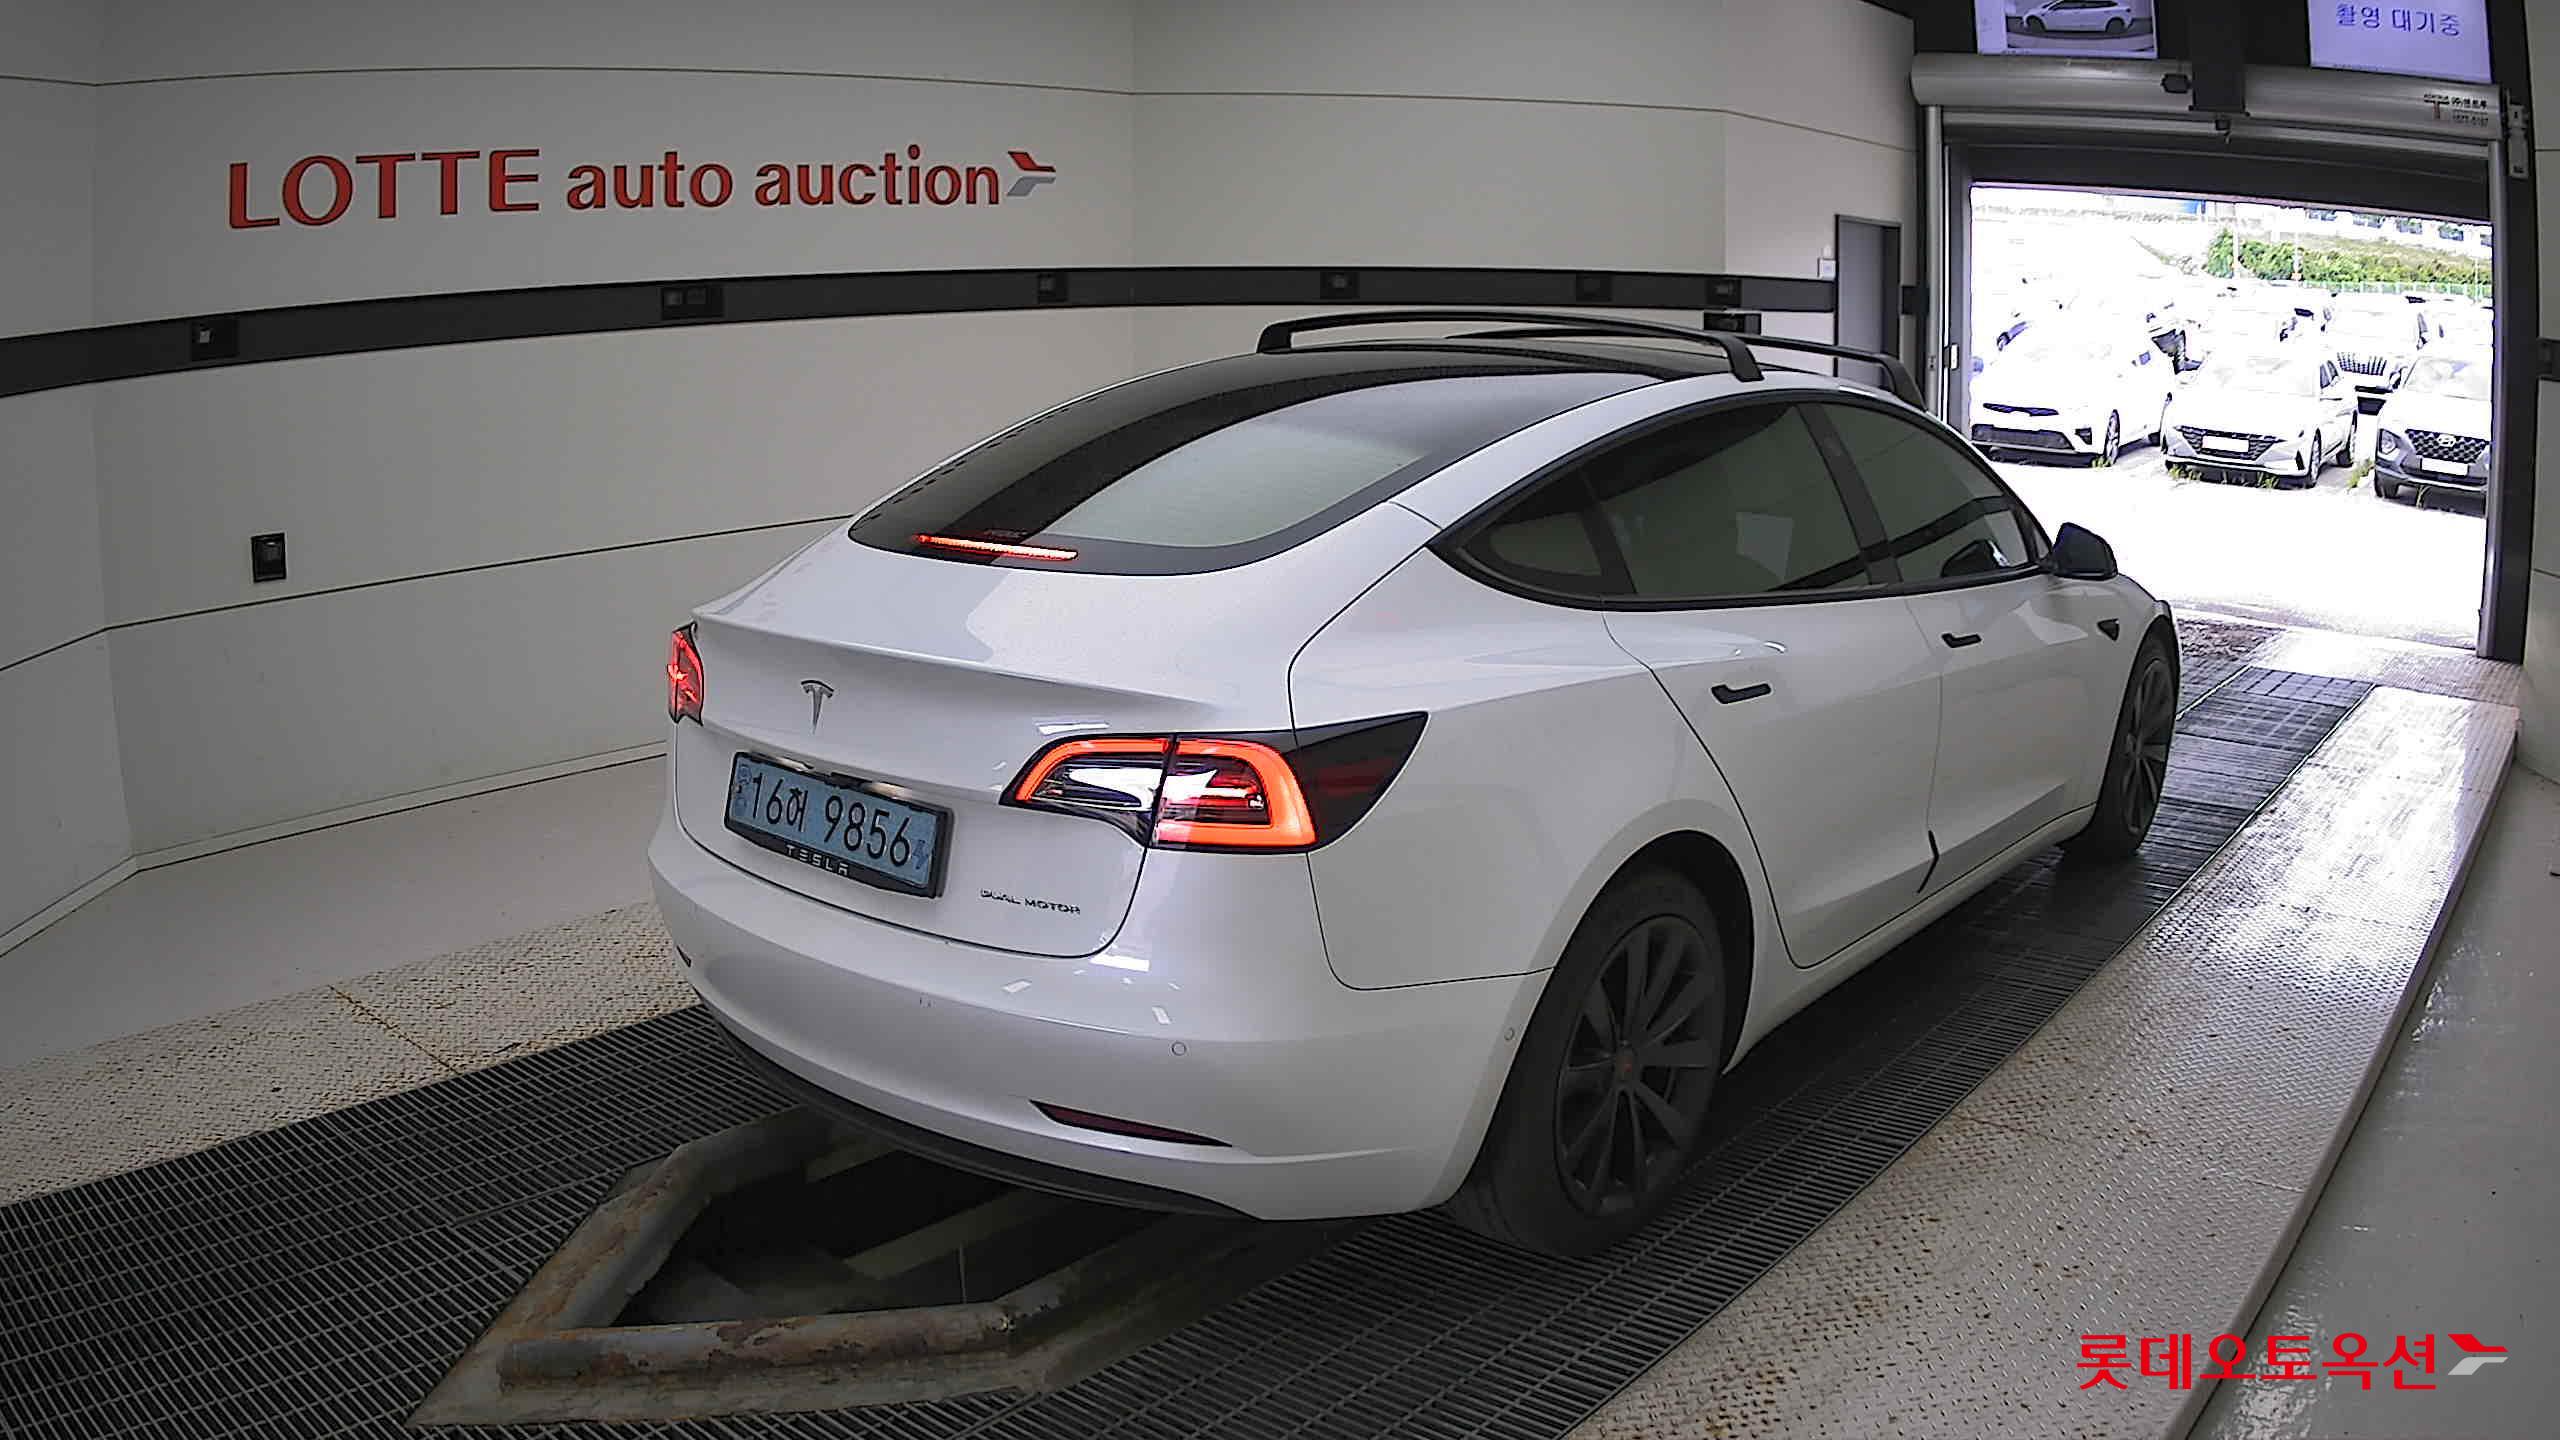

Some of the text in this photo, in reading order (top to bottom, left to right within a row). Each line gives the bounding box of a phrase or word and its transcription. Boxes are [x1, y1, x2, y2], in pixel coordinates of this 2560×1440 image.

[2337, 4, 2460, 37] 촬영 대기중
[229, 145, 1000, 229] LOTTE auto auction
[753, 772, 911, 867] 16허 9856
[786, 844, 849, 876] TESLA
[980, 888, 1081, 915] DUAL MOTOR
